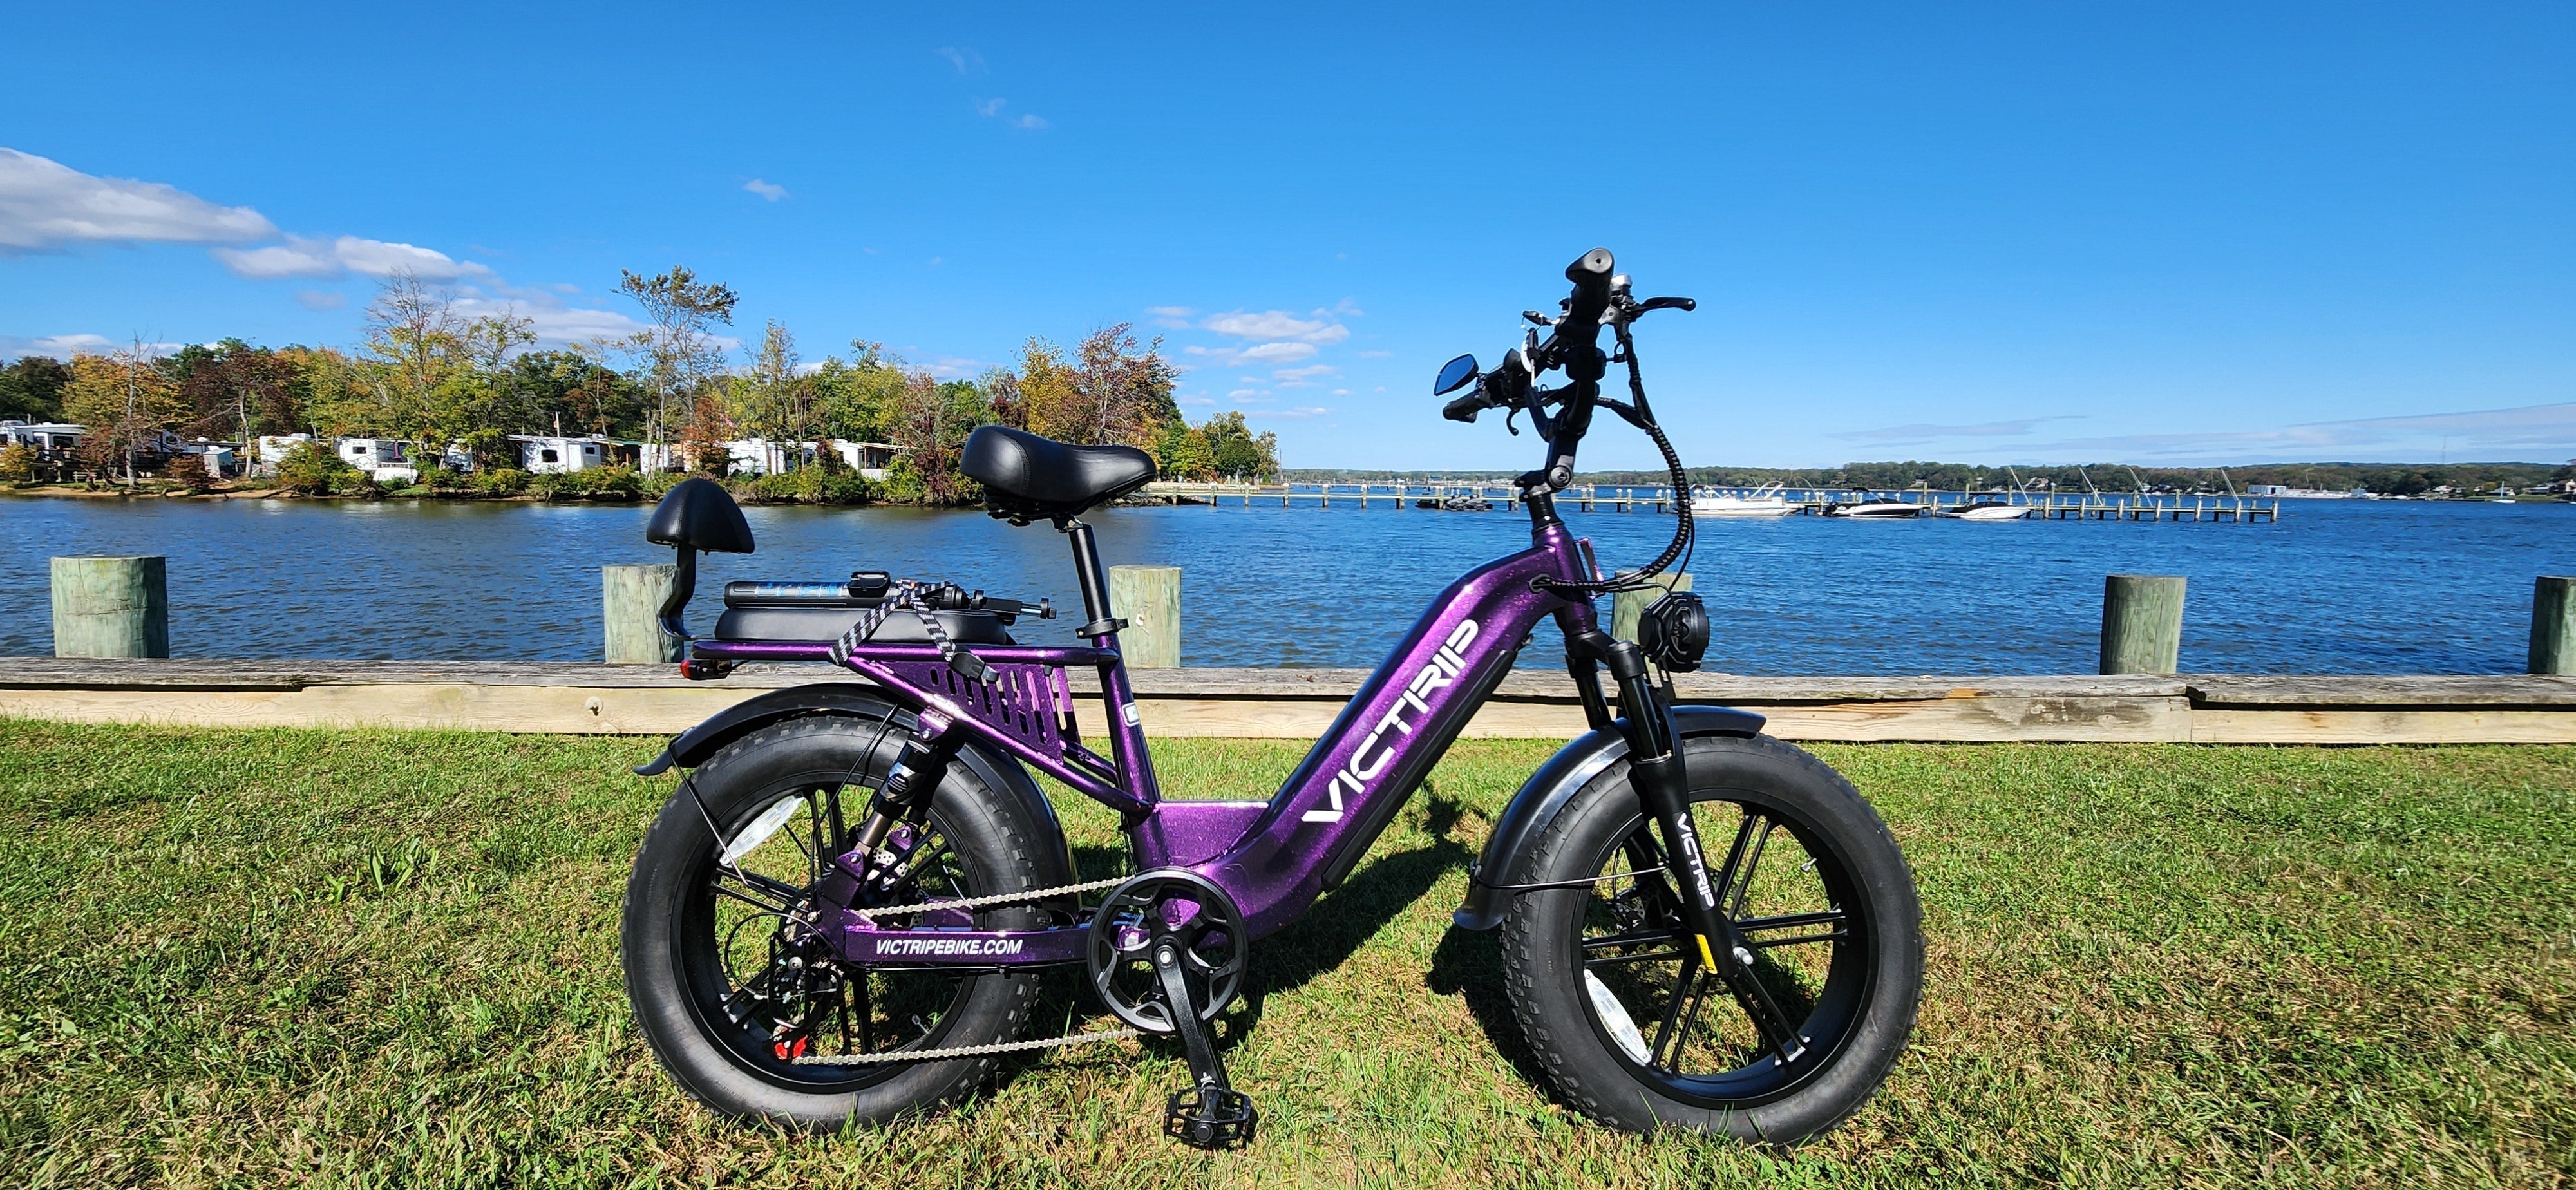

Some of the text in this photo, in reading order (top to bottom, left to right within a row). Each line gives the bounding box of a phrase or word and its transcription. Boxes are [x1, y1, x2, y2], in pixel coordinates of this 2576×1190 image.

[1302, 619, 1479, 823] VICTRIP
[1678, 813, 1714, 907] VICTRIP
[876, 940, 1023, 954] VICTRIPEBIKE.COM
